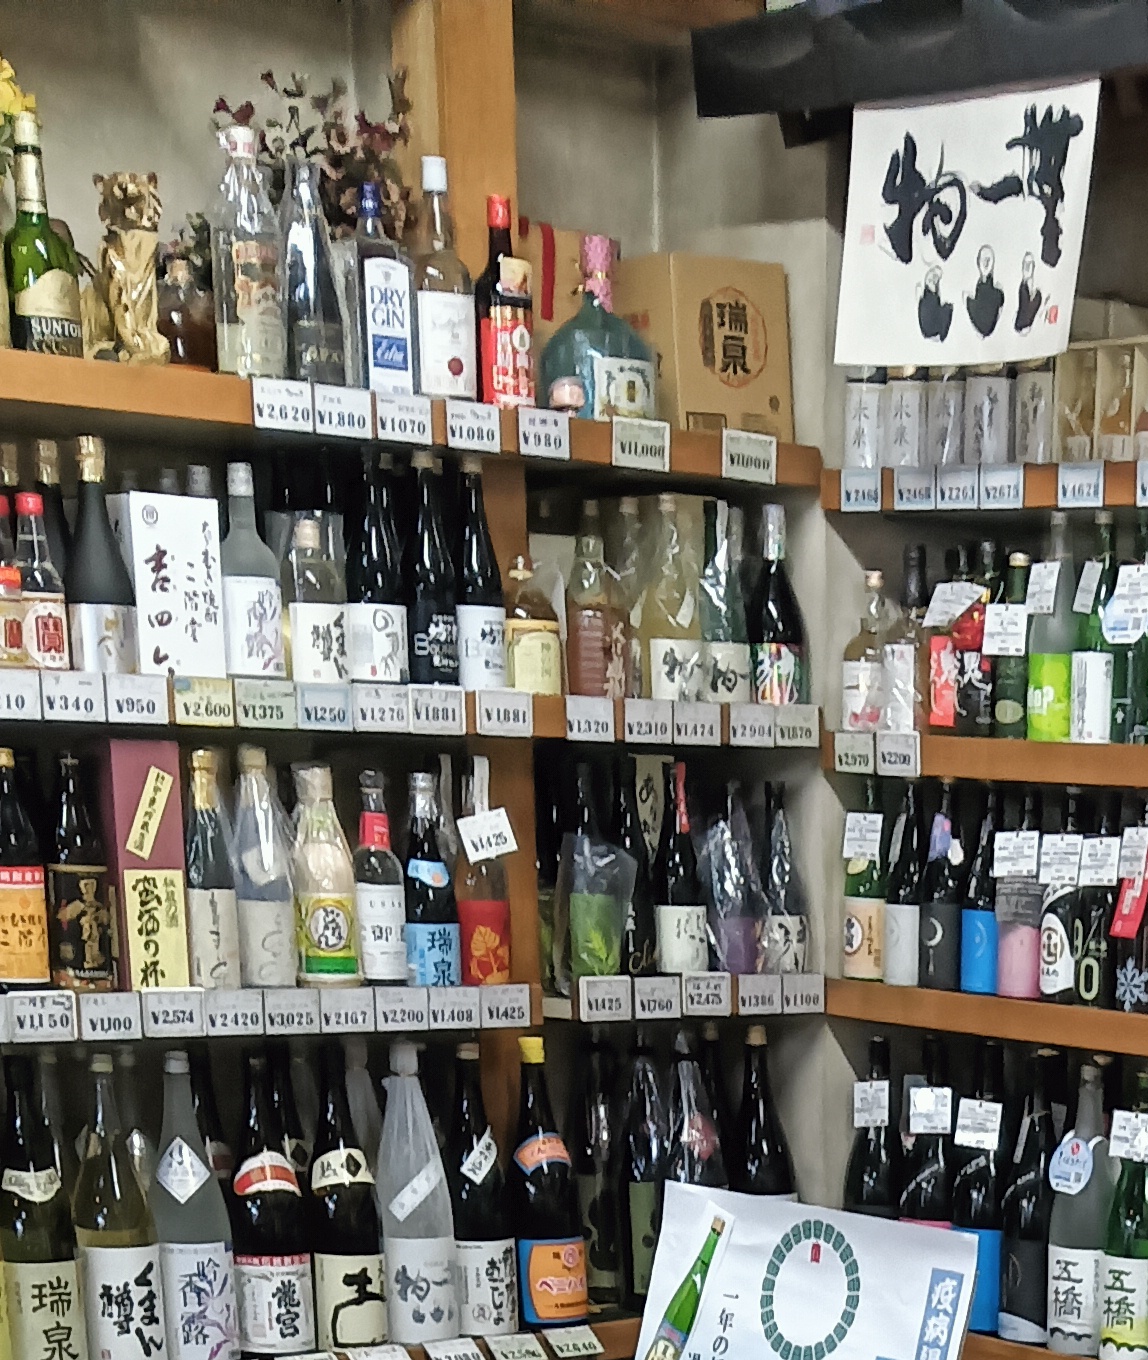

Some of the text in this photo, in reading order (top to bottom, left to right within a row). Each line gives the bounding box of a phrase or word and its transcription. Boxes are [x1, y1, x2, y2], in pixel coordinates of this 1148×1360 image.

[369, 284, 408, 305] DRY
[371, 306, 406, 330] GIN
[273, 1279, 301, 1339] 龍宮
[1051, 1259, 1083, 1321] 五橋
[1103, 1268, 1136, 1331] 五橋
